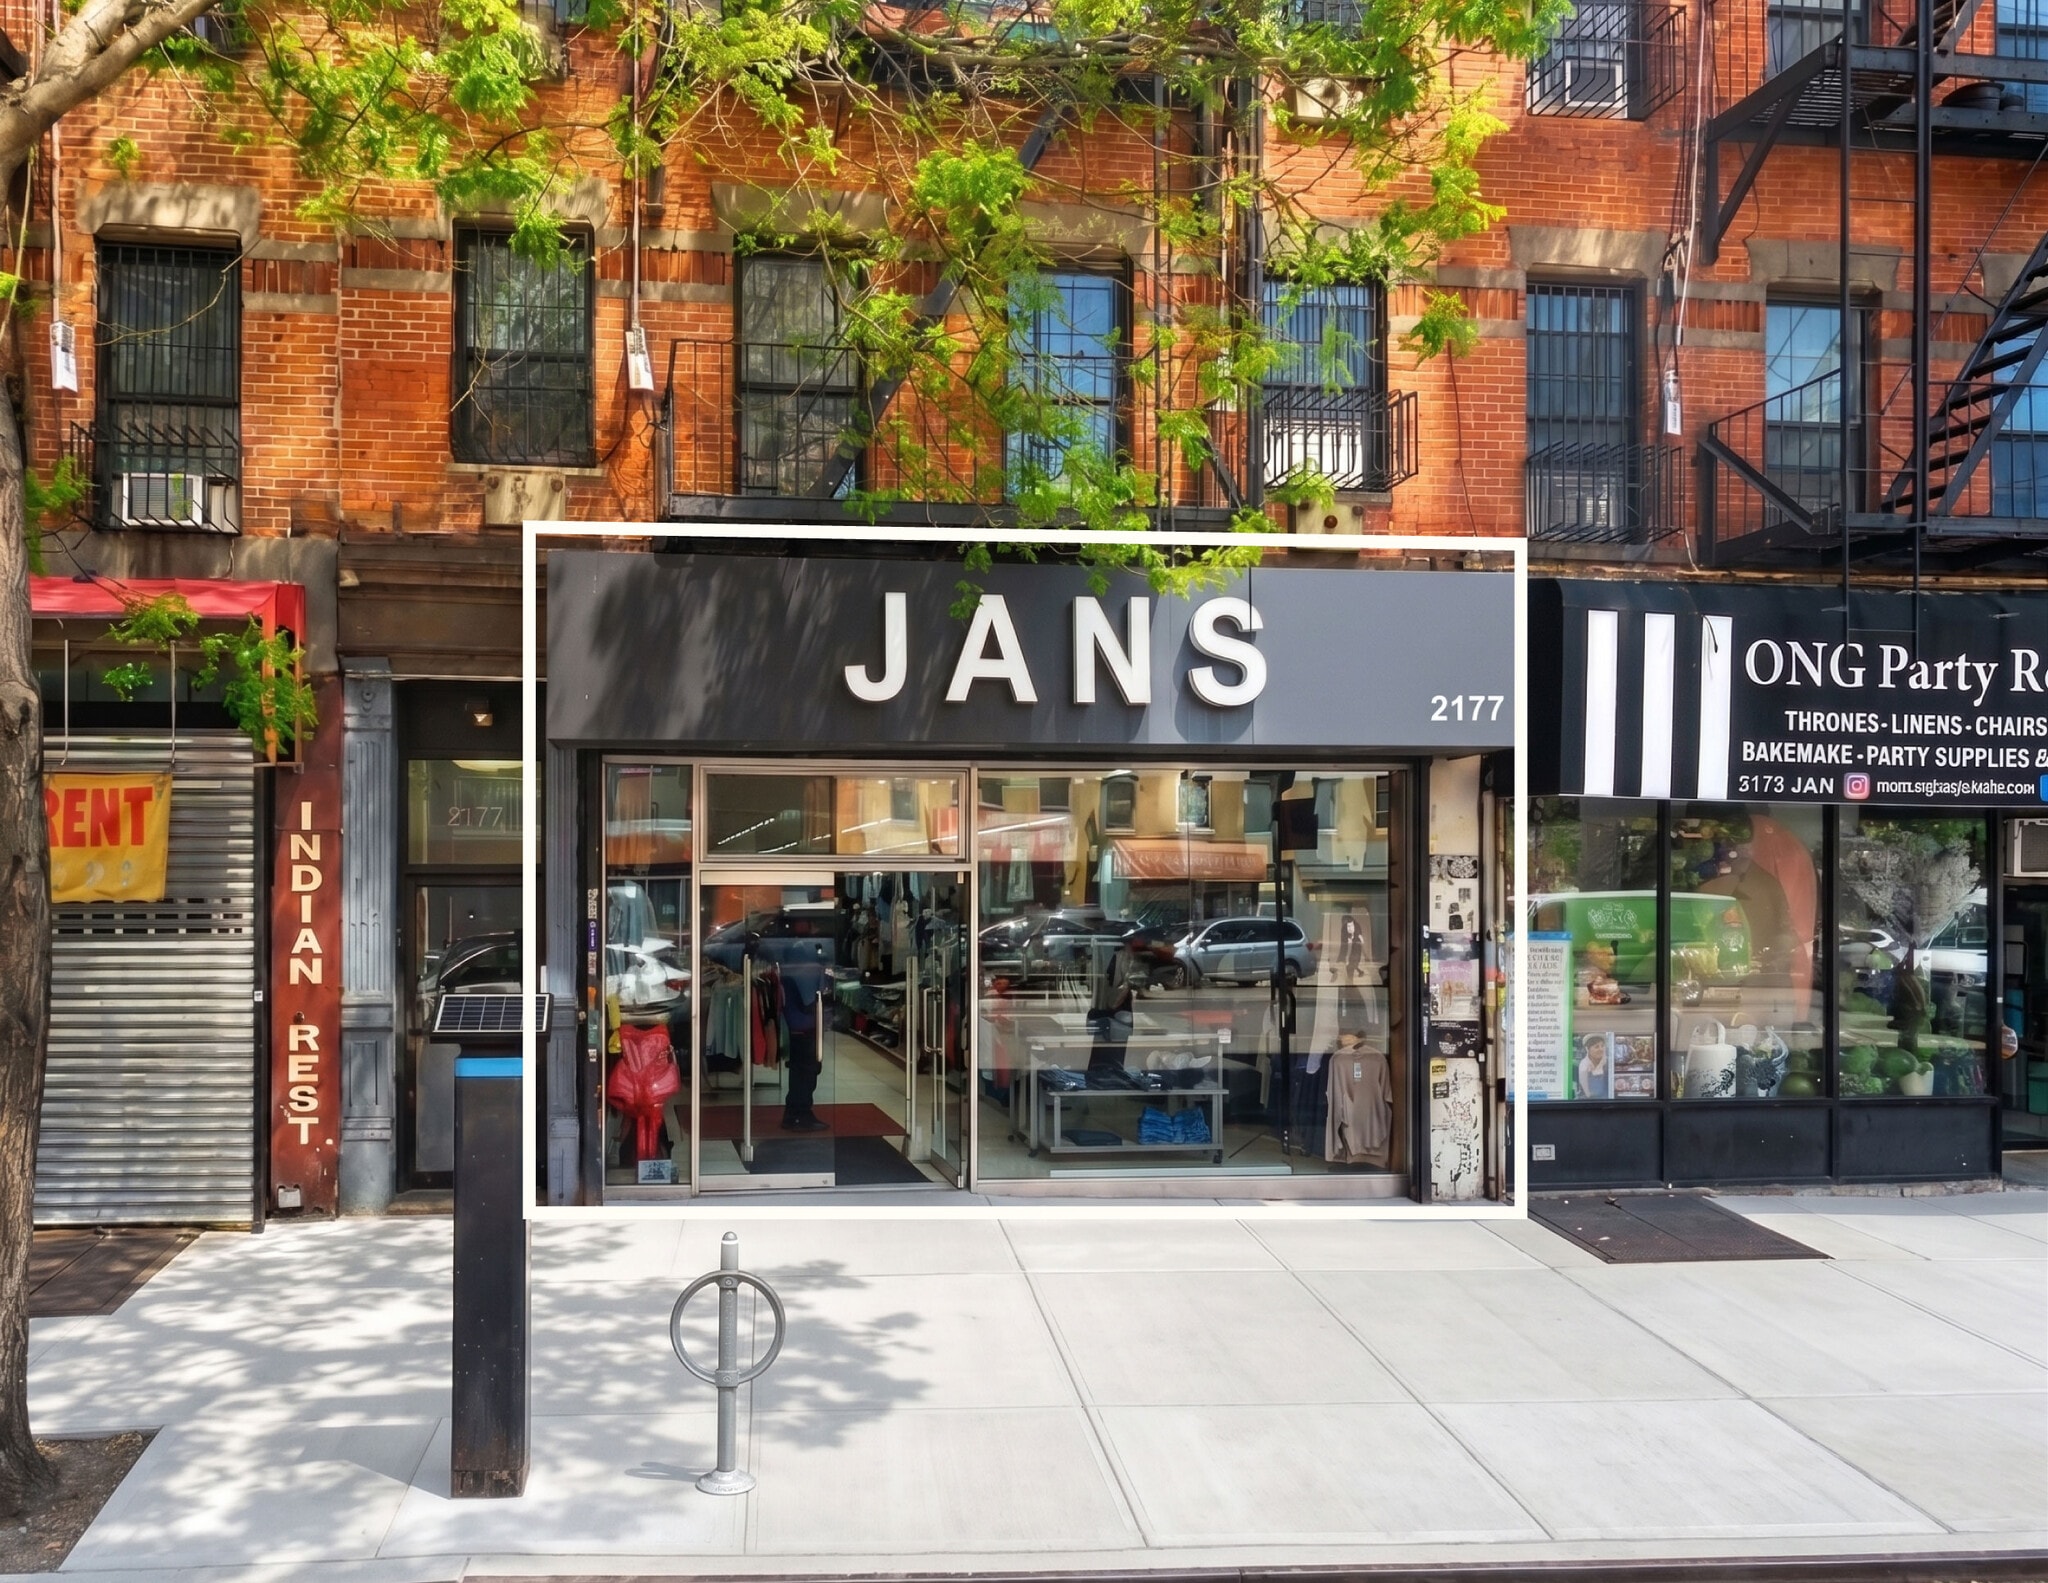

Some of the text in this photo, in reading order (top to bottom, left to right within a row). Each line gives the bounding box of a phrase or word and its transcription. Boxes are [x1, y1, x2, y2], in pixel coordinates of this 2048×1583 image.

[843, 591, 1269, 707] JANS
[1745, 639, 2048, 707] ONG Party R
[1430, 694, 1505, 721] 2177
[1935, 746, 2030, 769] SUPPLIES
[1791, 776, 1835, 794] JAN
[44, 786, 153, 848] RENT
[447, 806, 504, 828] 2177
[287, 801, 323, 1145] INDIAN REST
